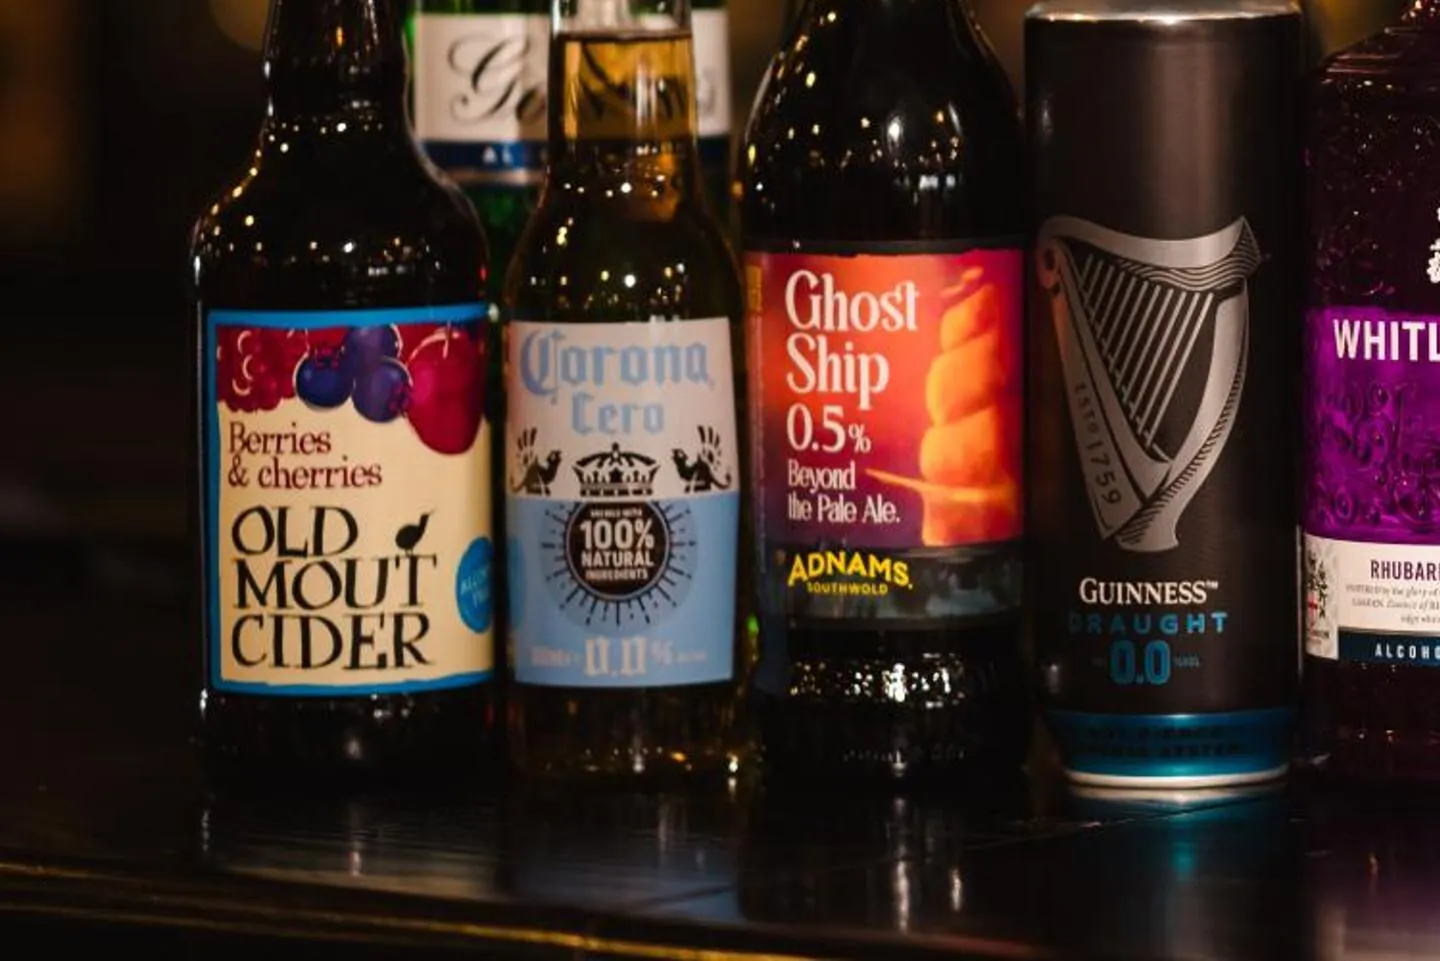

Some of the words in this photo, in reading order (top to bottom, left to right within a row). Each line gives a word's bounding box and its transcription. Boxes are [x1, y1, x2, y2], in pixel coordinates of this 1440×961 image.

[785, 269, 920, 332] Ghost
[520, 329, 709, 404] Corona
[786, 333, 889, 410] Ship
[573, 392, 664, 435] Cero
[787, 404, 871, 453] 0.5%
[229, 422, 331, 454] Berries
[228, 462, 248, 488] &
[258, 457, 382, 489] cherries
[788, 459, 856, 493] Beyond
[1085, 441, 1122, 504] 1759
[788, 496, 812, 522] the
[817, 494, 858, 523] Pale
[862, 495, 901, 524] Ale.
[231, 506, 358, 558] OLD
[580, 520, 655, 550] 100%
[581, 550, 655, 568] NATURAL
[233, 554, 437, 609] MOUT
[807, 582, 889, 595] SOUTHWOLD
[1079, 577, 1209, 604] GUINNESS
[231, 613, 435, 669] CIDER
[1068, 612, 1228, 634] DRAUGHT
[1110, 639, 1170, 685] 0.0
